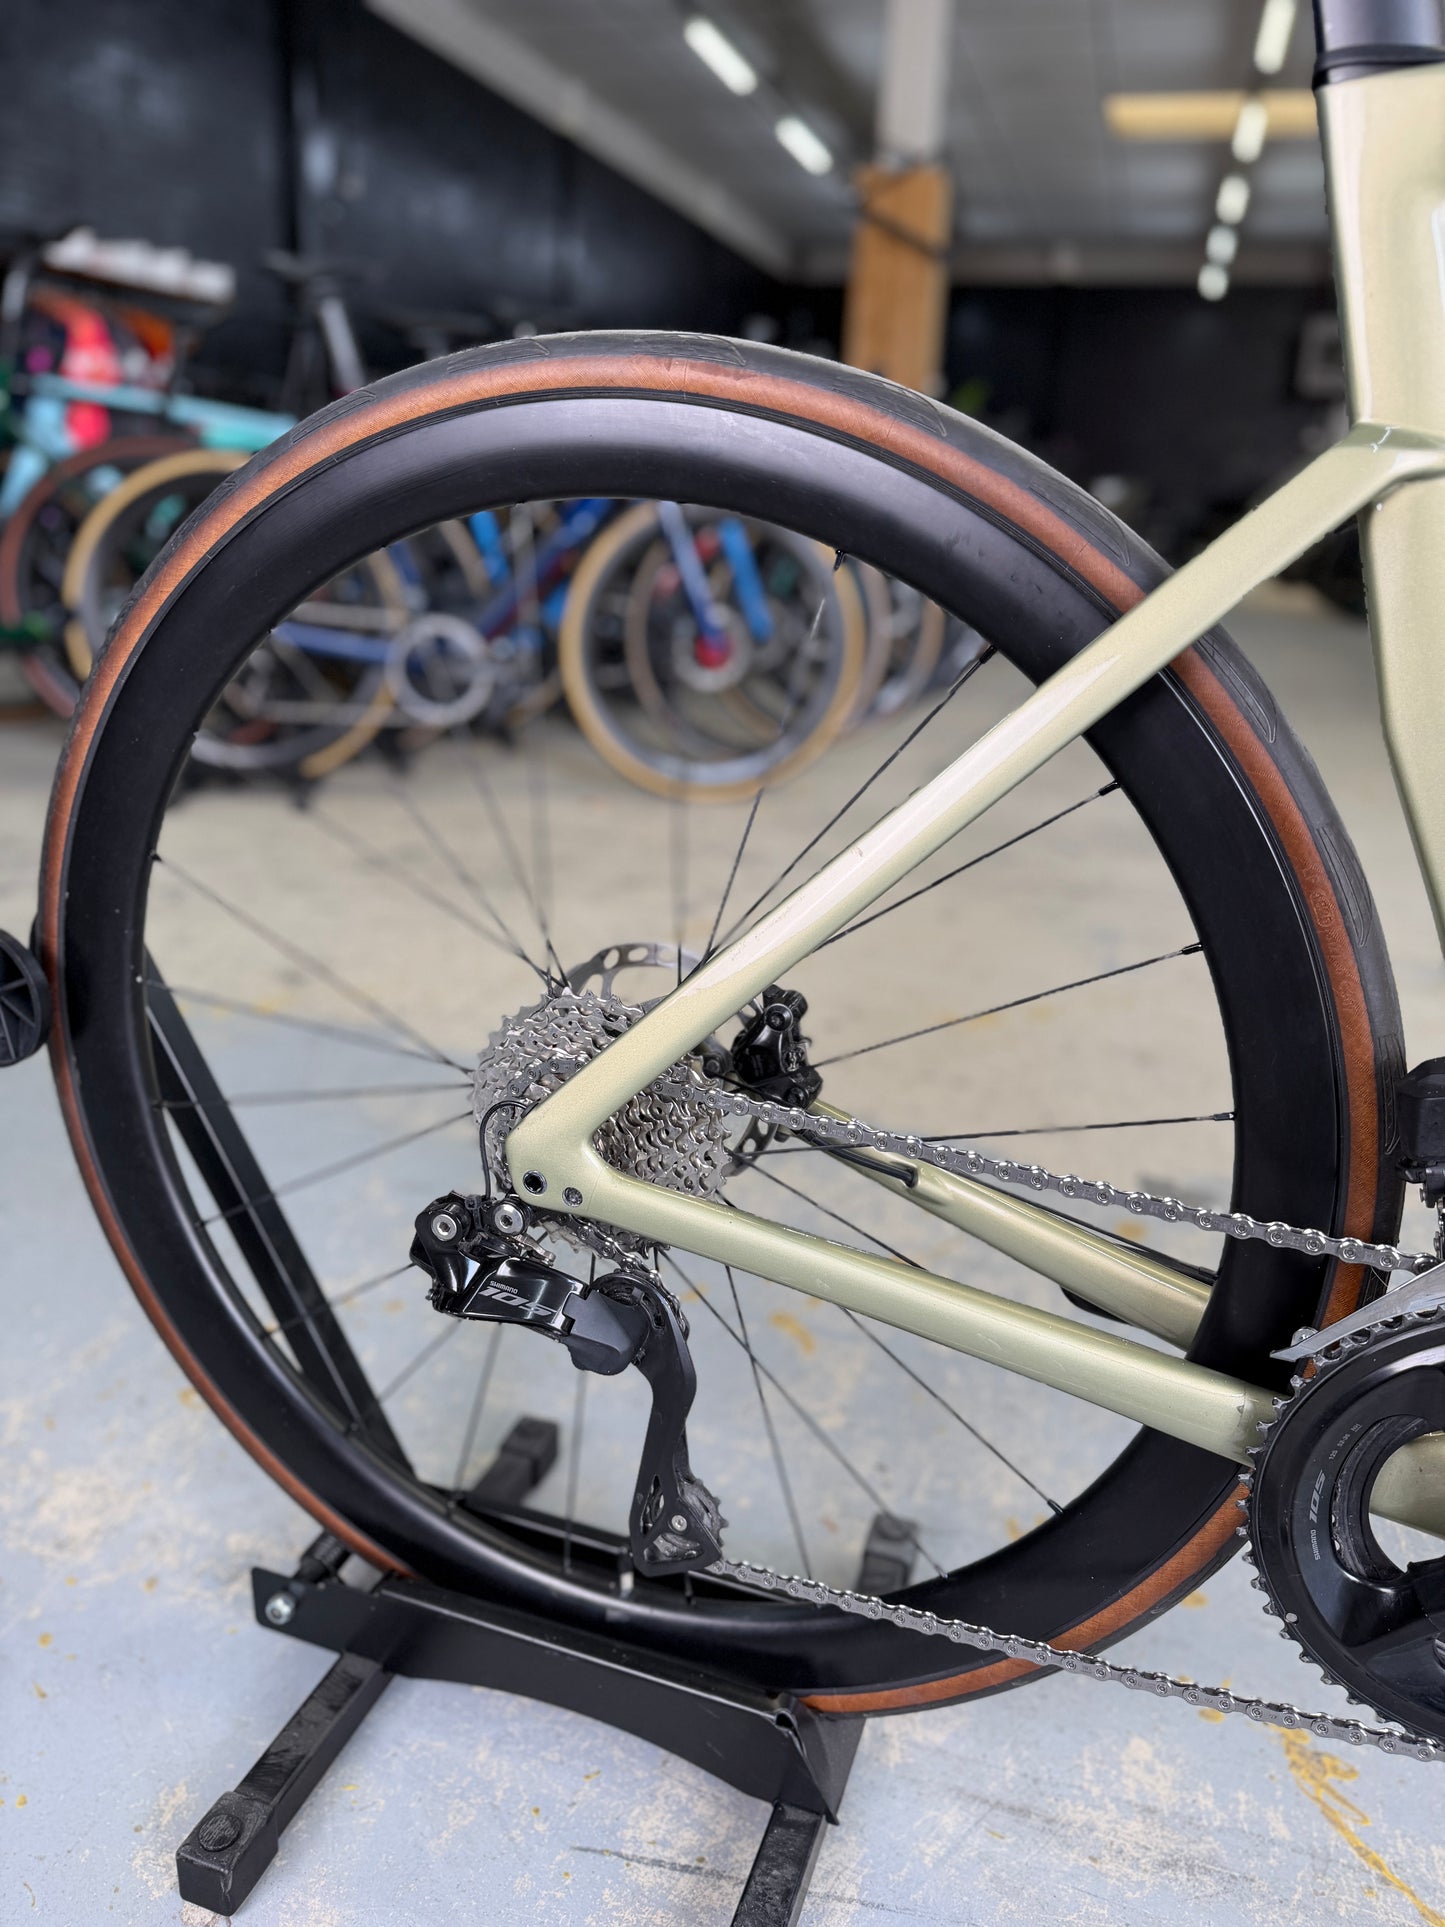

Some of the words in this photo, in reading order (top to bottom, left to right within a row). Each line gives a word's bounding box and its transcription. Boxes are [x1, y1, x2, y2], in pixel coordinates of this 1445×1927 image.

[478, 1286, 557, 1316] 105
[489, 1280, 518, 1294] SHIMANO
[1310, 1469, 1326, 1523] 105
[1311, 1529, 1321, 1561] SHIMANO
